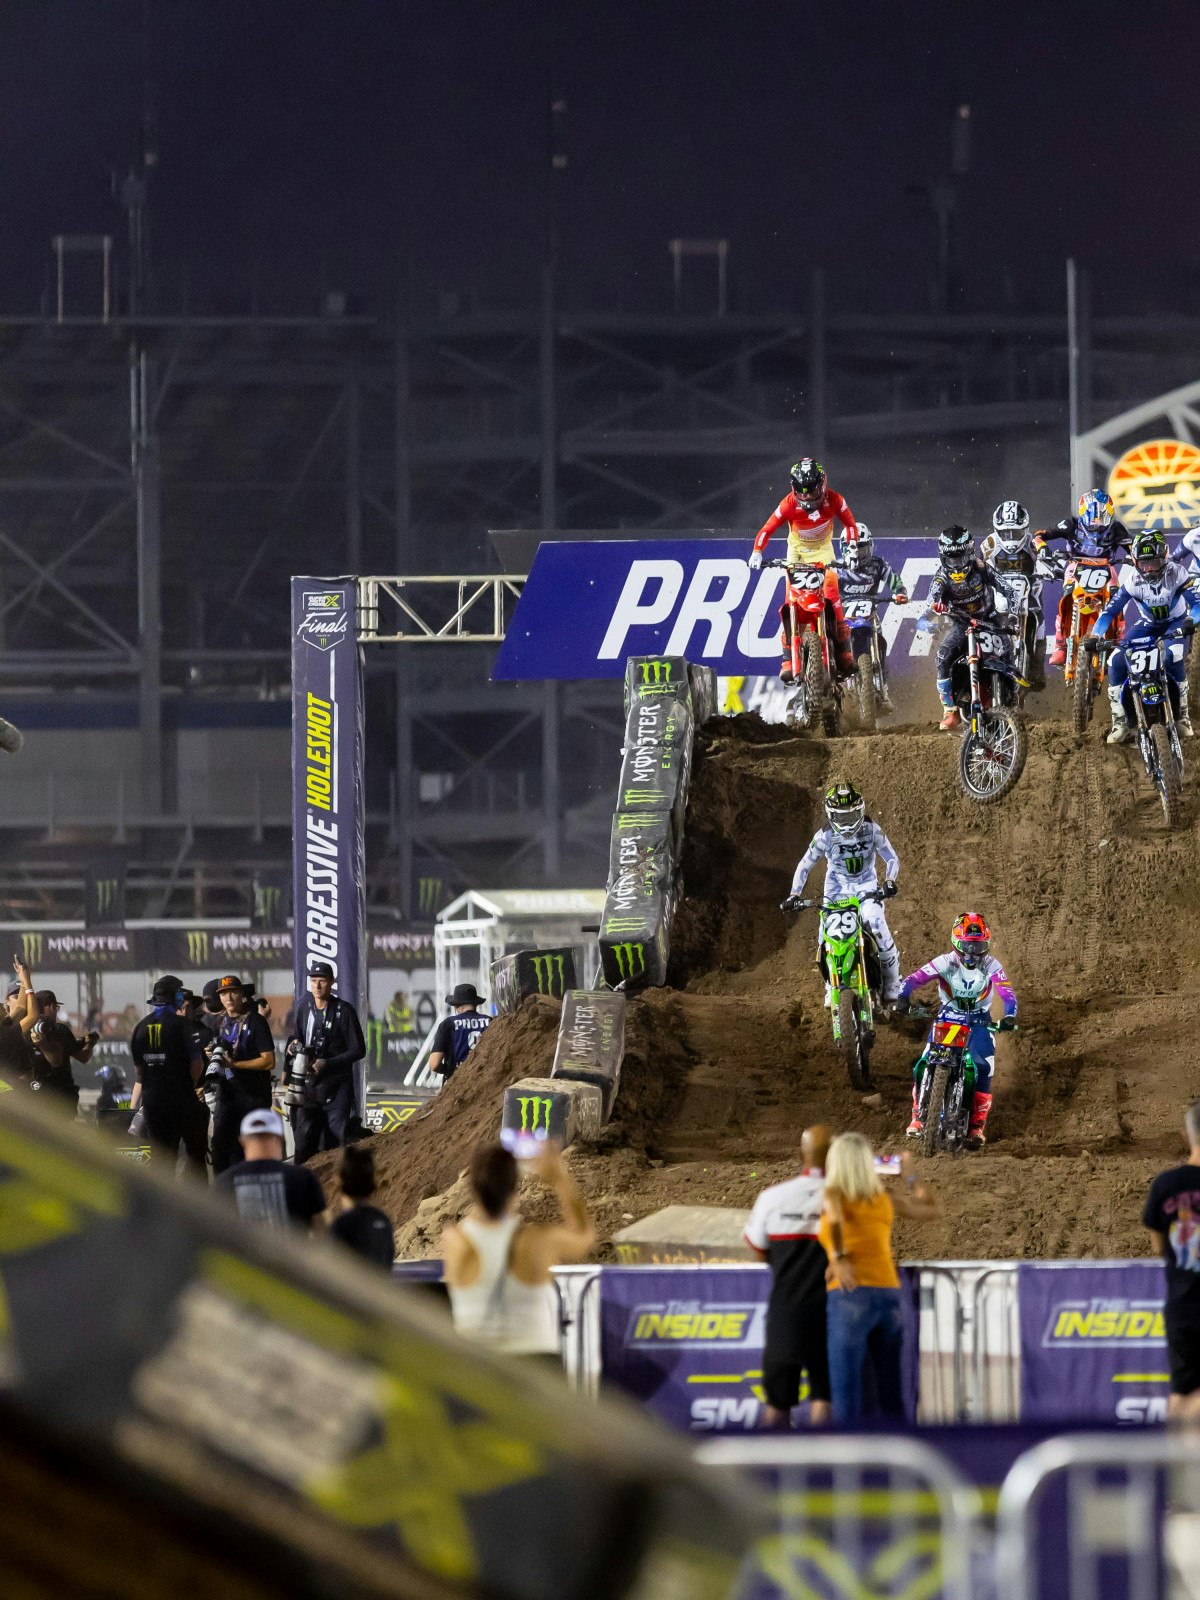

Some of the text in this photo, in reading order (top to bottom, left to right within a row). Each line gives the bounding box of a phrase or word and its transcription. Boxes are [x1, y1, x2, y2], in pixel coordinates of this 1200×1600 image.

[790, 571, 825, 589] 30
[1077, 568, 1109, 589] 16
[844, 600, 873, 618] 73
[297, 611, 348, 635] Finals
[979, 631, 1004, 656] 39
[1131, 648, 1159, 674] 31
[306, 692, 332, 811] HOLESHOT
[630, 703, 661, 782] MONSTER
[306, 814, 339, 997] OGRESSIVE
[826, 911, 857, 937] 29
[48, 934, 130, 952] MONSTER
[213, 933, 293, 951] MONSTER
[942, 1025, 961, 1045] 1
[634, 1313, 748, 1339] INSIDE
